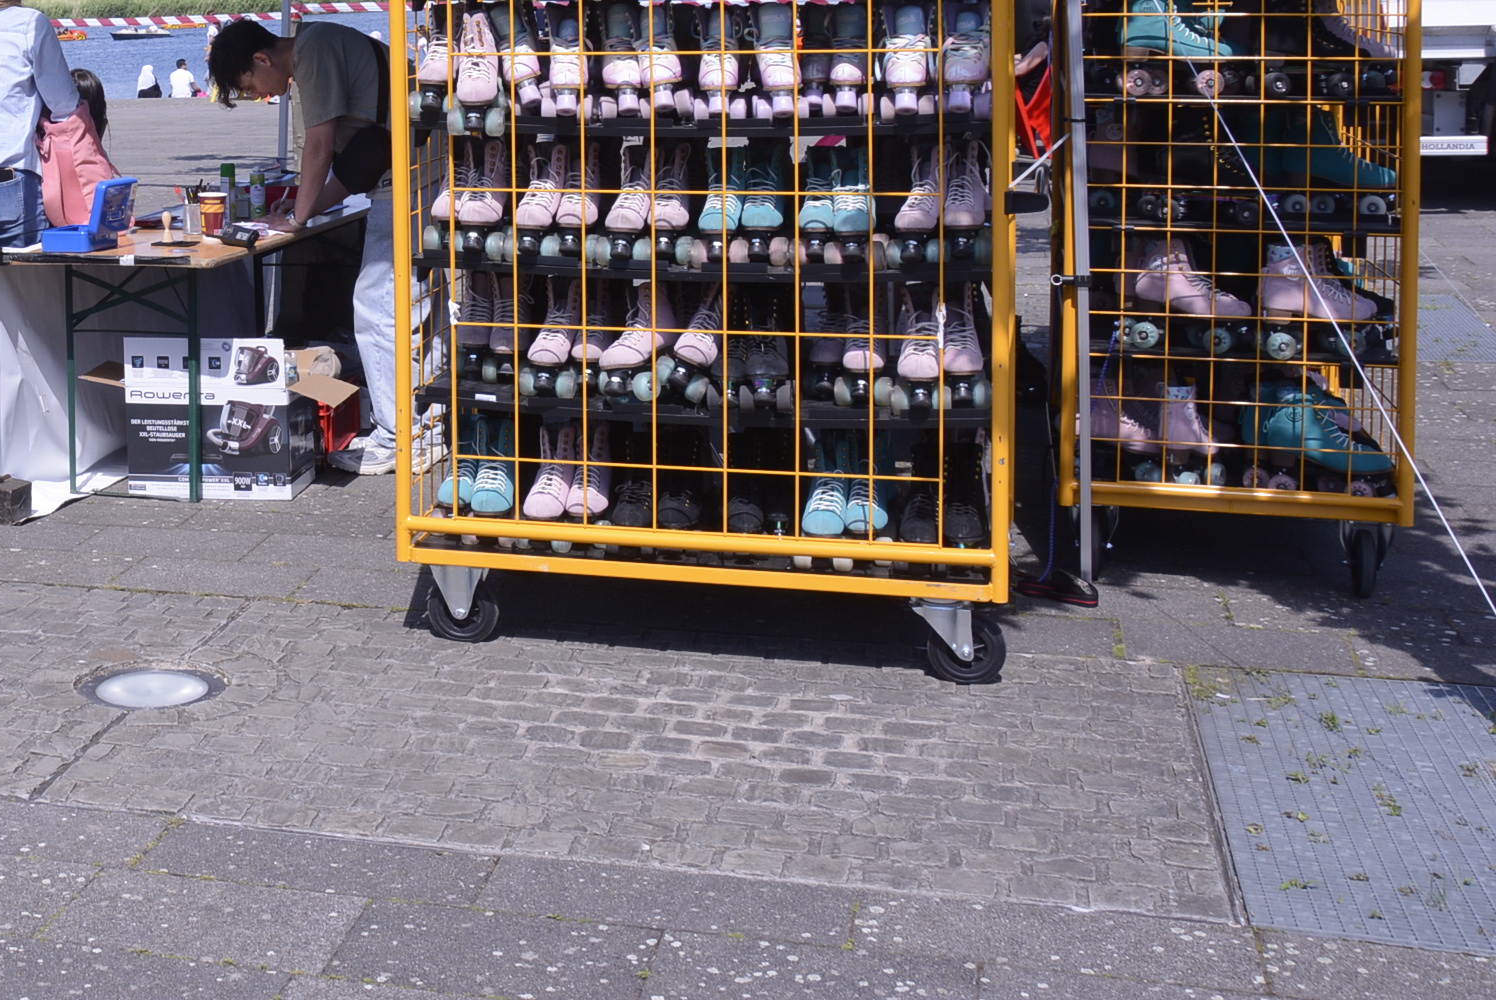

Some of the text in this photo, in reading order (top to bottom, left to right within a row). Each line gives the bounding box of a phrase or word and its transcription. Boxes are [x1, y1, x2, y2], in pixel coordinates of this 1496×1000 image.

[130, 390, 215, 400] Rowena
[141, 418, 190, 426] LEISTUNGSSTÄRKST
[232, 417, 247, 429] XXL
[235, 476, 252, 486] 900W
